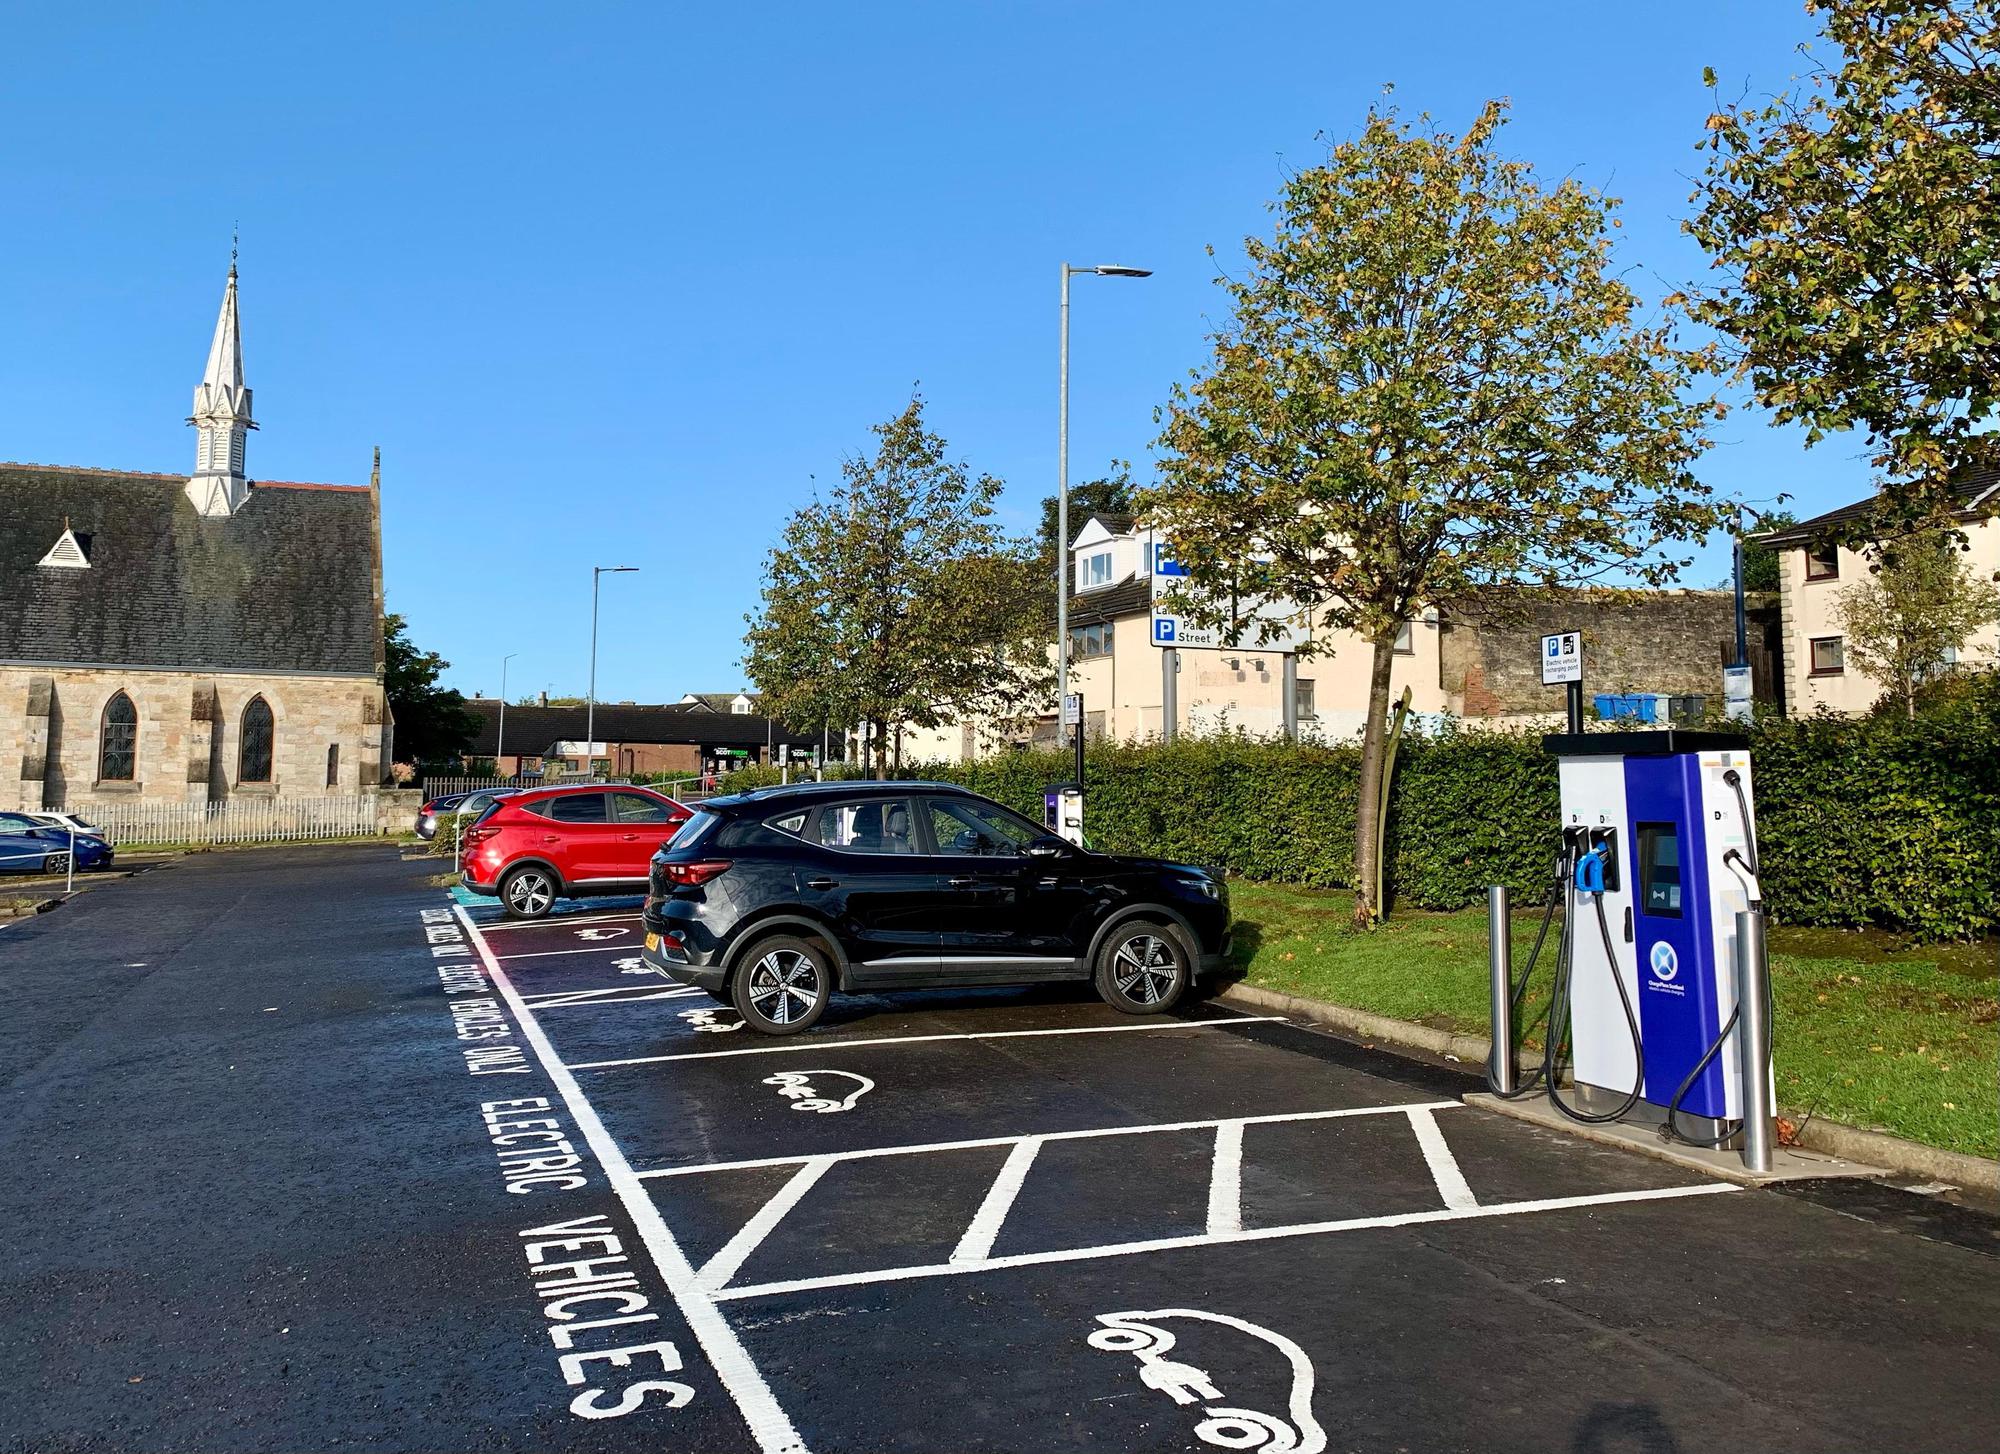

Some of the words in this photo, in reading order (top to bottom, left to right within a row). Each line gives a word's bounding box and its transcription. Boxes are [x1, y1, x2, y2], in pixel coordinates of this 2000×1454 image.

[1160, 622, 1173, 639] P
[1178, 632, 1211, 643] Street
[437, 965, 489, 994] ELECTRIC
[449, 998, 511, 1040] VEHICLES
[463, 1046, 532, 1075] ONLY
[481, 1097, 587, 1194] ELECTRIC
[518, 1215, 695, 1419] VEHICLES
